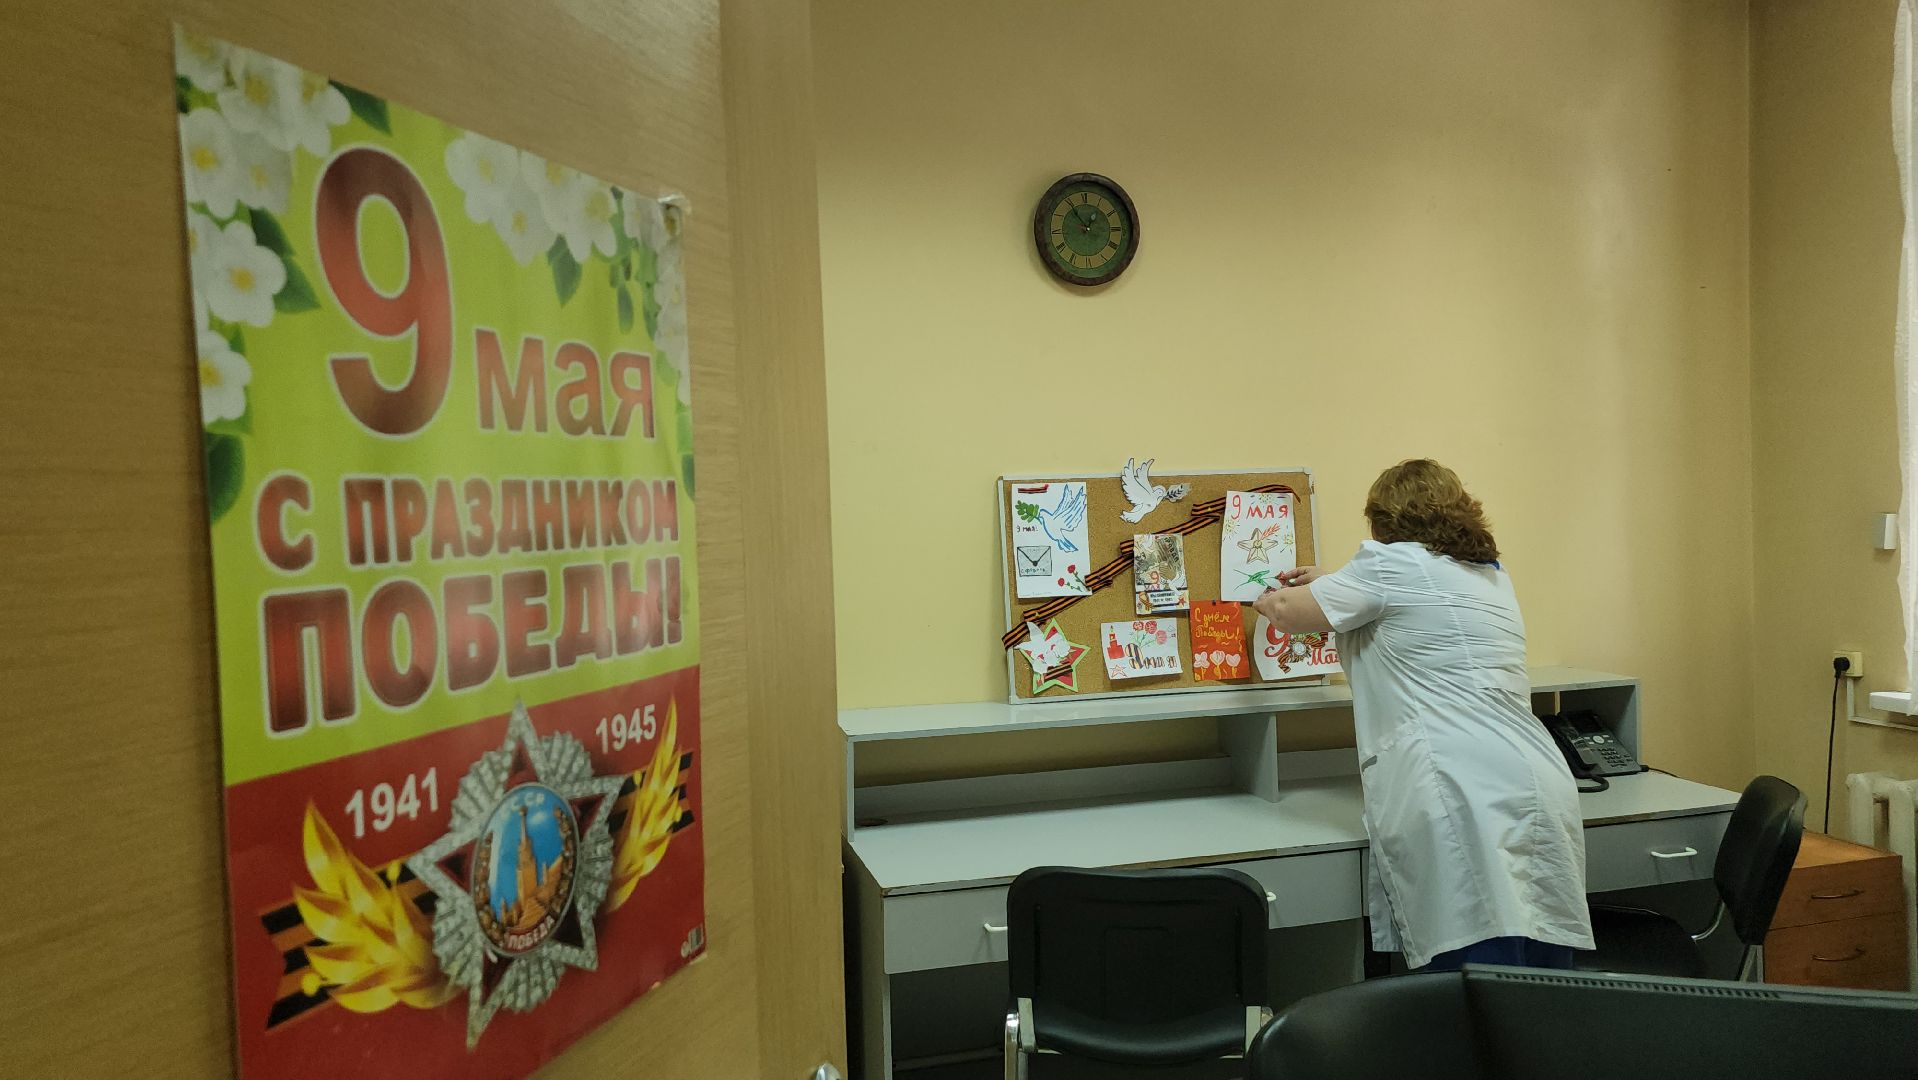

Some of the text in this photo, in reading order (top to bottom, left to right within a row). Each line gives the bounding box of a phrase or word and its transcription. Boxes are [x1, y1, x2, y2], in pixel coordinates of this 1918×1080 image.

[314, 145, 655, 440] 9 мая
[256, 474, 681, 572] С ПРАЗДНИКОМ
[1230, 494, 1289, 520] 9 МАЯ
[1194, 607, 1202, 622] С
[262, 556, 683, 736] ПОБЕДЫ!
[1263, 622, 1340, 666] 9 Ма
[595, 704, 657, 754] 1945
[344, 768, 440, 838] 1941
[507, 914, 555, 950] ПОБЕДА
